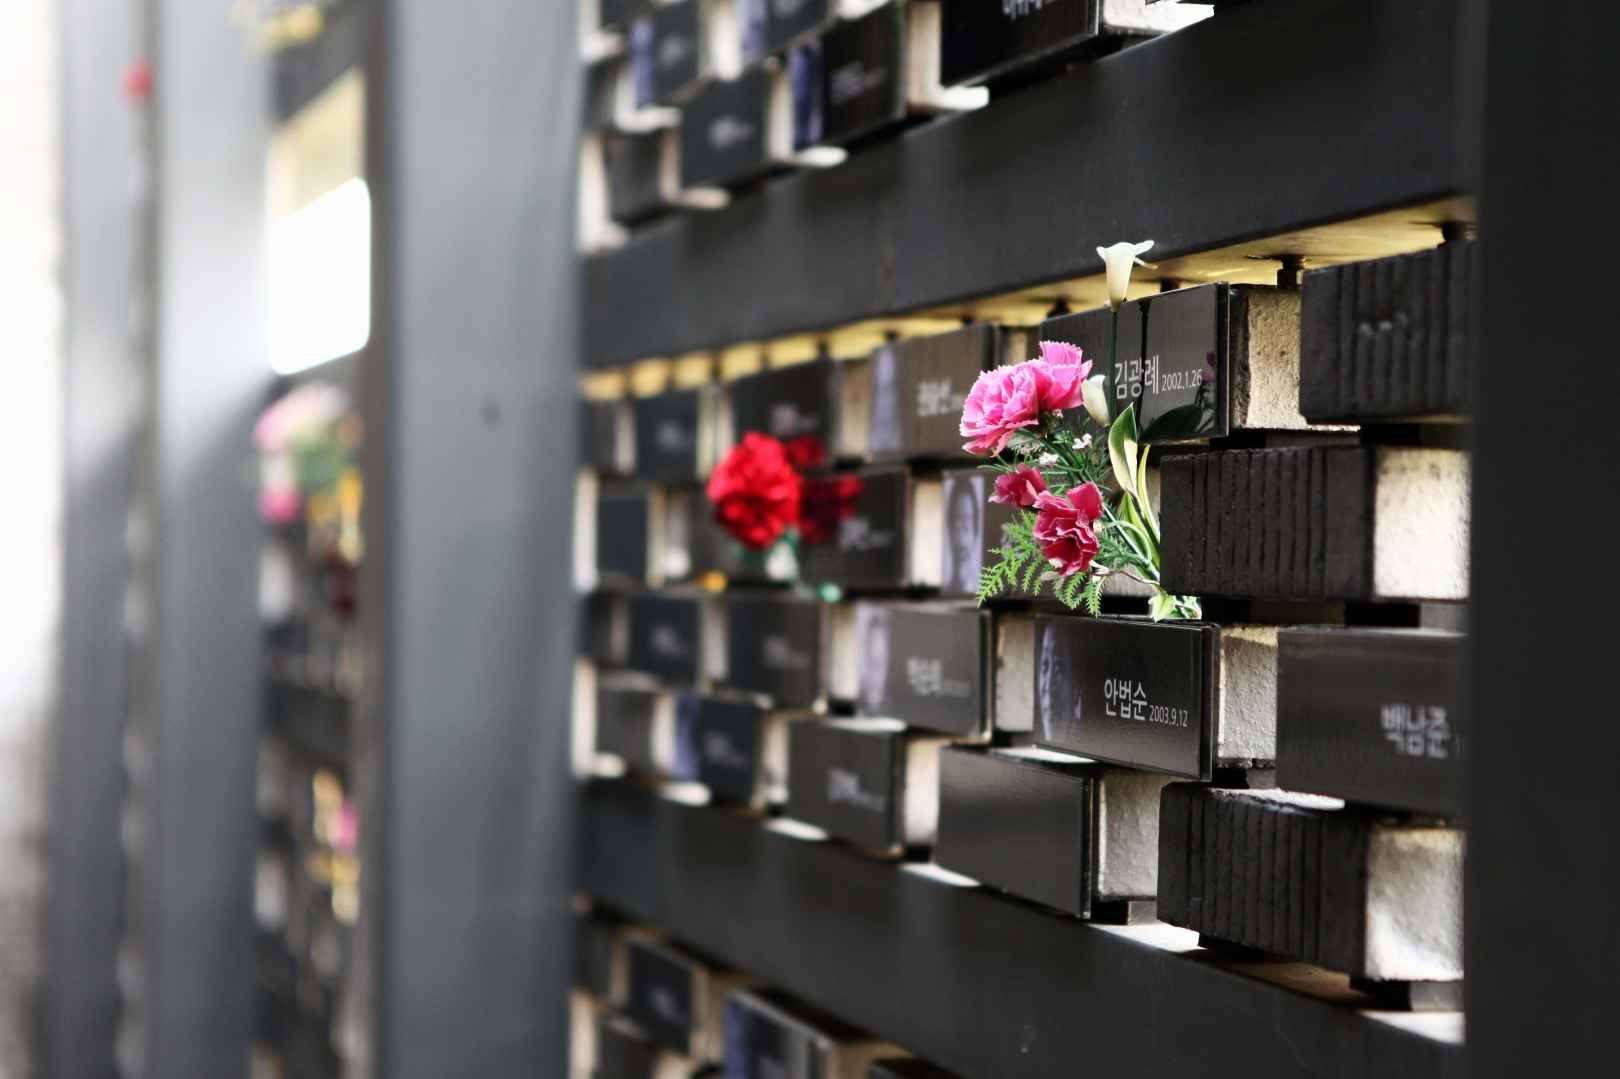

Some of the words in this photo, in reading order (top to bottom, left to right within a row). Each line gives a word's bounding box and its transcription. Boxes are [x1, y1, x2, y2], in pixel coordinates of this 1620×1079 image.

[1114, 354, 1159, 400] 김광례
[1104, 678, 1148, 721] 안법순
[1149, 704, 1189, 728] 2003.9.12
